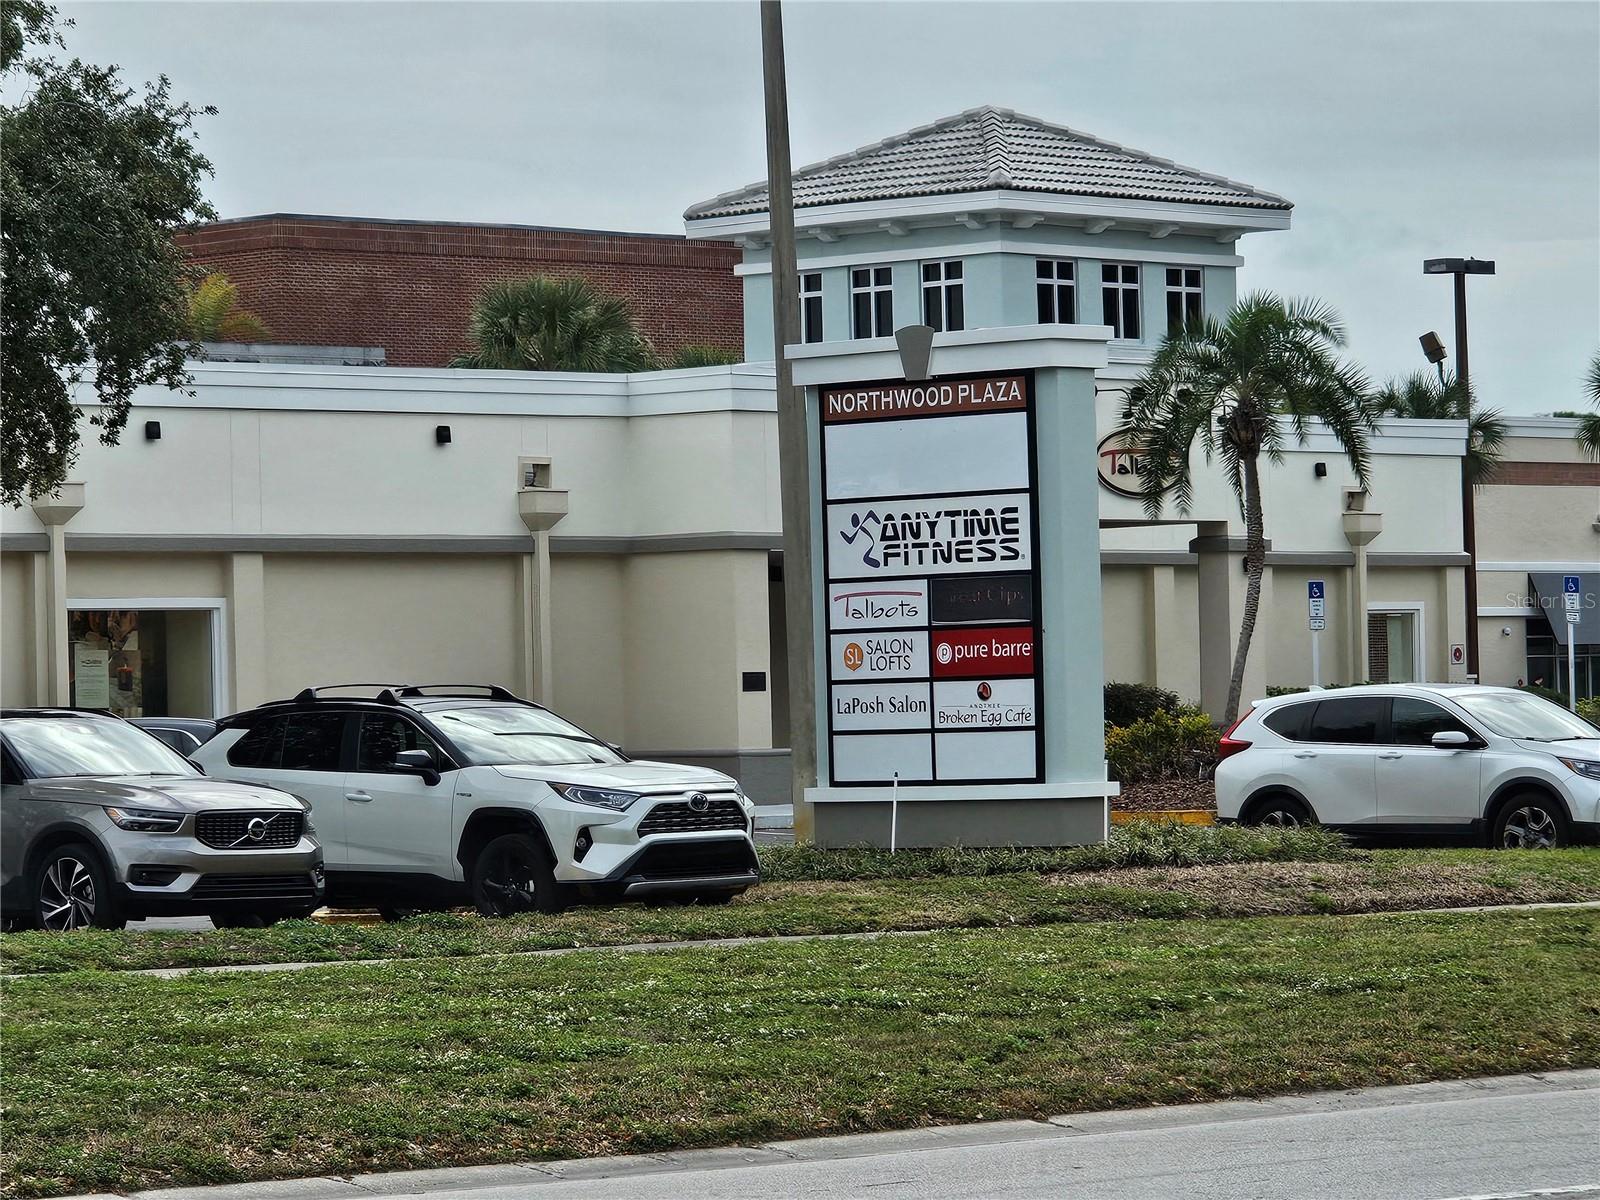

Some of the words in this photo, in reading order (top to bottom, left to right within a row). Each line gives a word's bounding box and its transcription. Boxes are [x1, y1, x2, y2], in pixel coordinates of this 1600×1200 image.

[829, 387, 953, 414] NORTHWOOD
[958, 381, 1022, 404] PLAZA
[880, 507, 1020, 541] ANYTIME
[883, 538, 1020, 566] FITNESS
[834, 591, 922, 619] Talbots
[846, 648, 862, 665] SL
[866, 638, 914, 655] SALON
[955, 644, 988, 663] pure
[992, 639, 1031, 657] barre
[870, 655, 911, 671] LOFTS
[837, 696, 884, 714] LaPosh
[889, 695, 927, 713] Salon
[938, 710, 977, 724] Broken
[981, 709, 1002, 726] Egg
